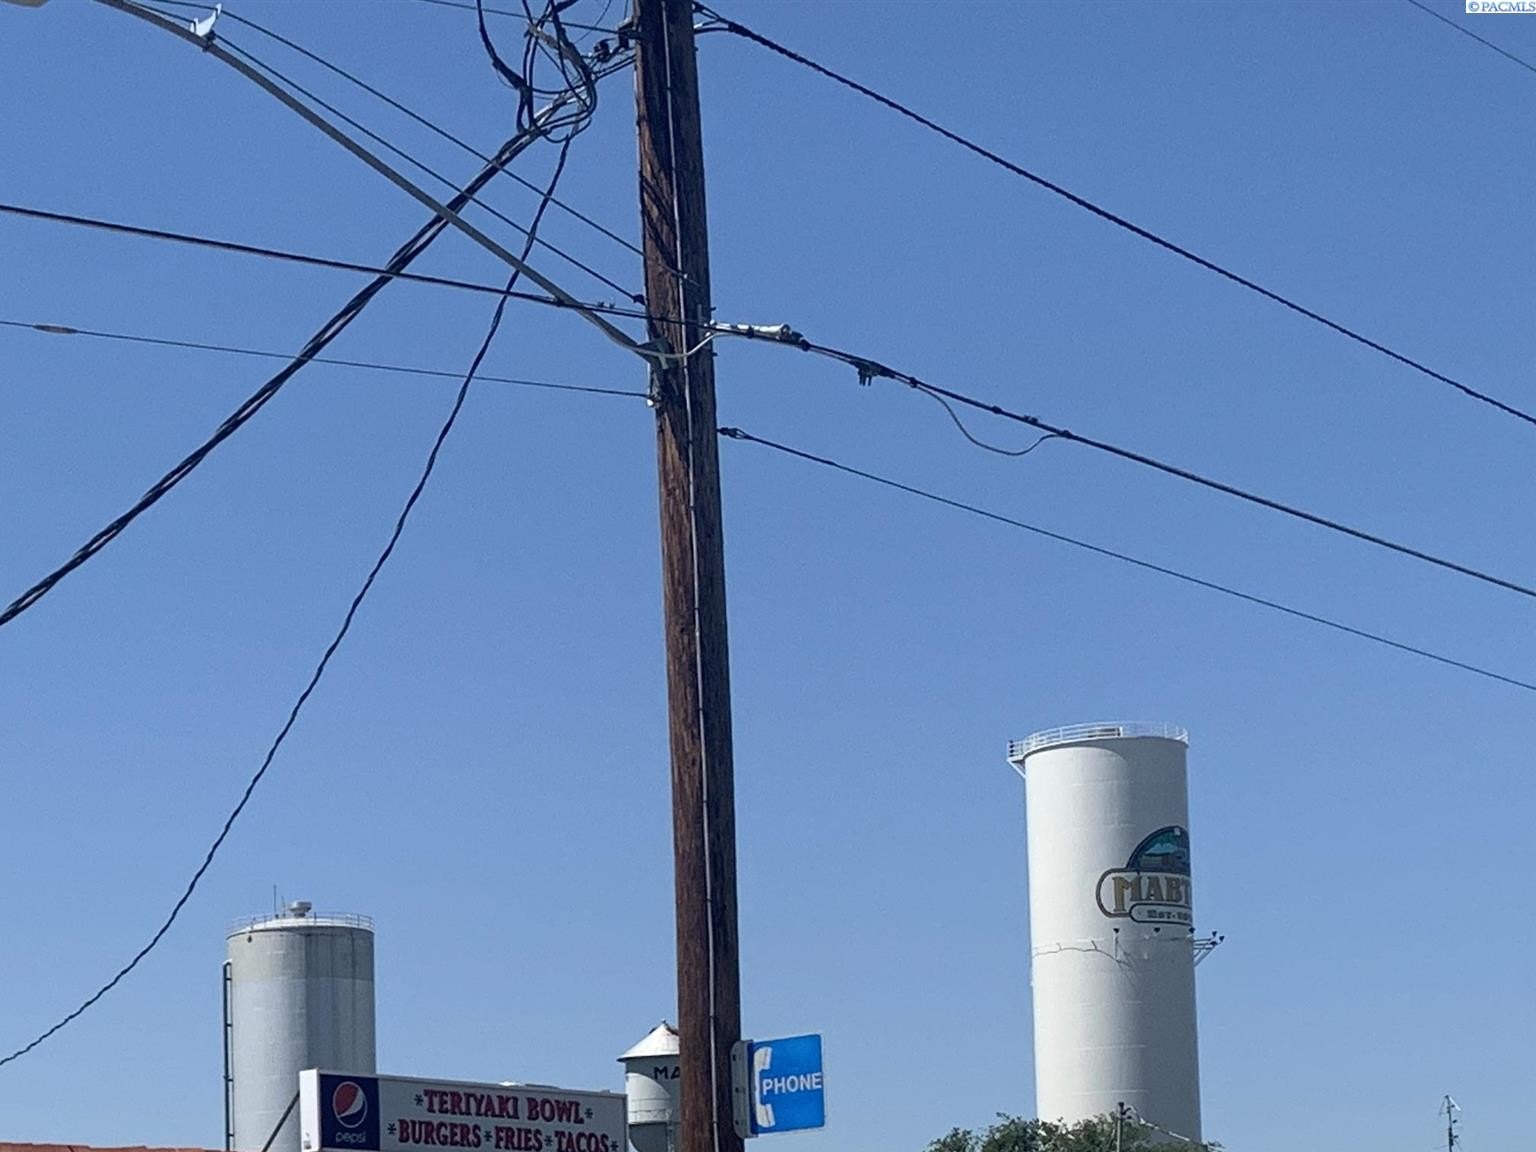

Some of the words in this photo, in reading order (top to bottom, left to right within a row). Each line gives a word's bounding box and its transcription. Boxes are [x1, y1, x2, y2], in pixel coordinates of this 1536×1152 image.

[763, 1072, 823, 1096] PHONE
[423, 1089, 520, 1120] TERIYAKI
[527, 1097, 585, 1125] BOWL
[335, 1131, 367, 1144] pepsi
[397, 1118, 482, 1148] BURGERS
[494, 1126, 543, 1152] FRIES
